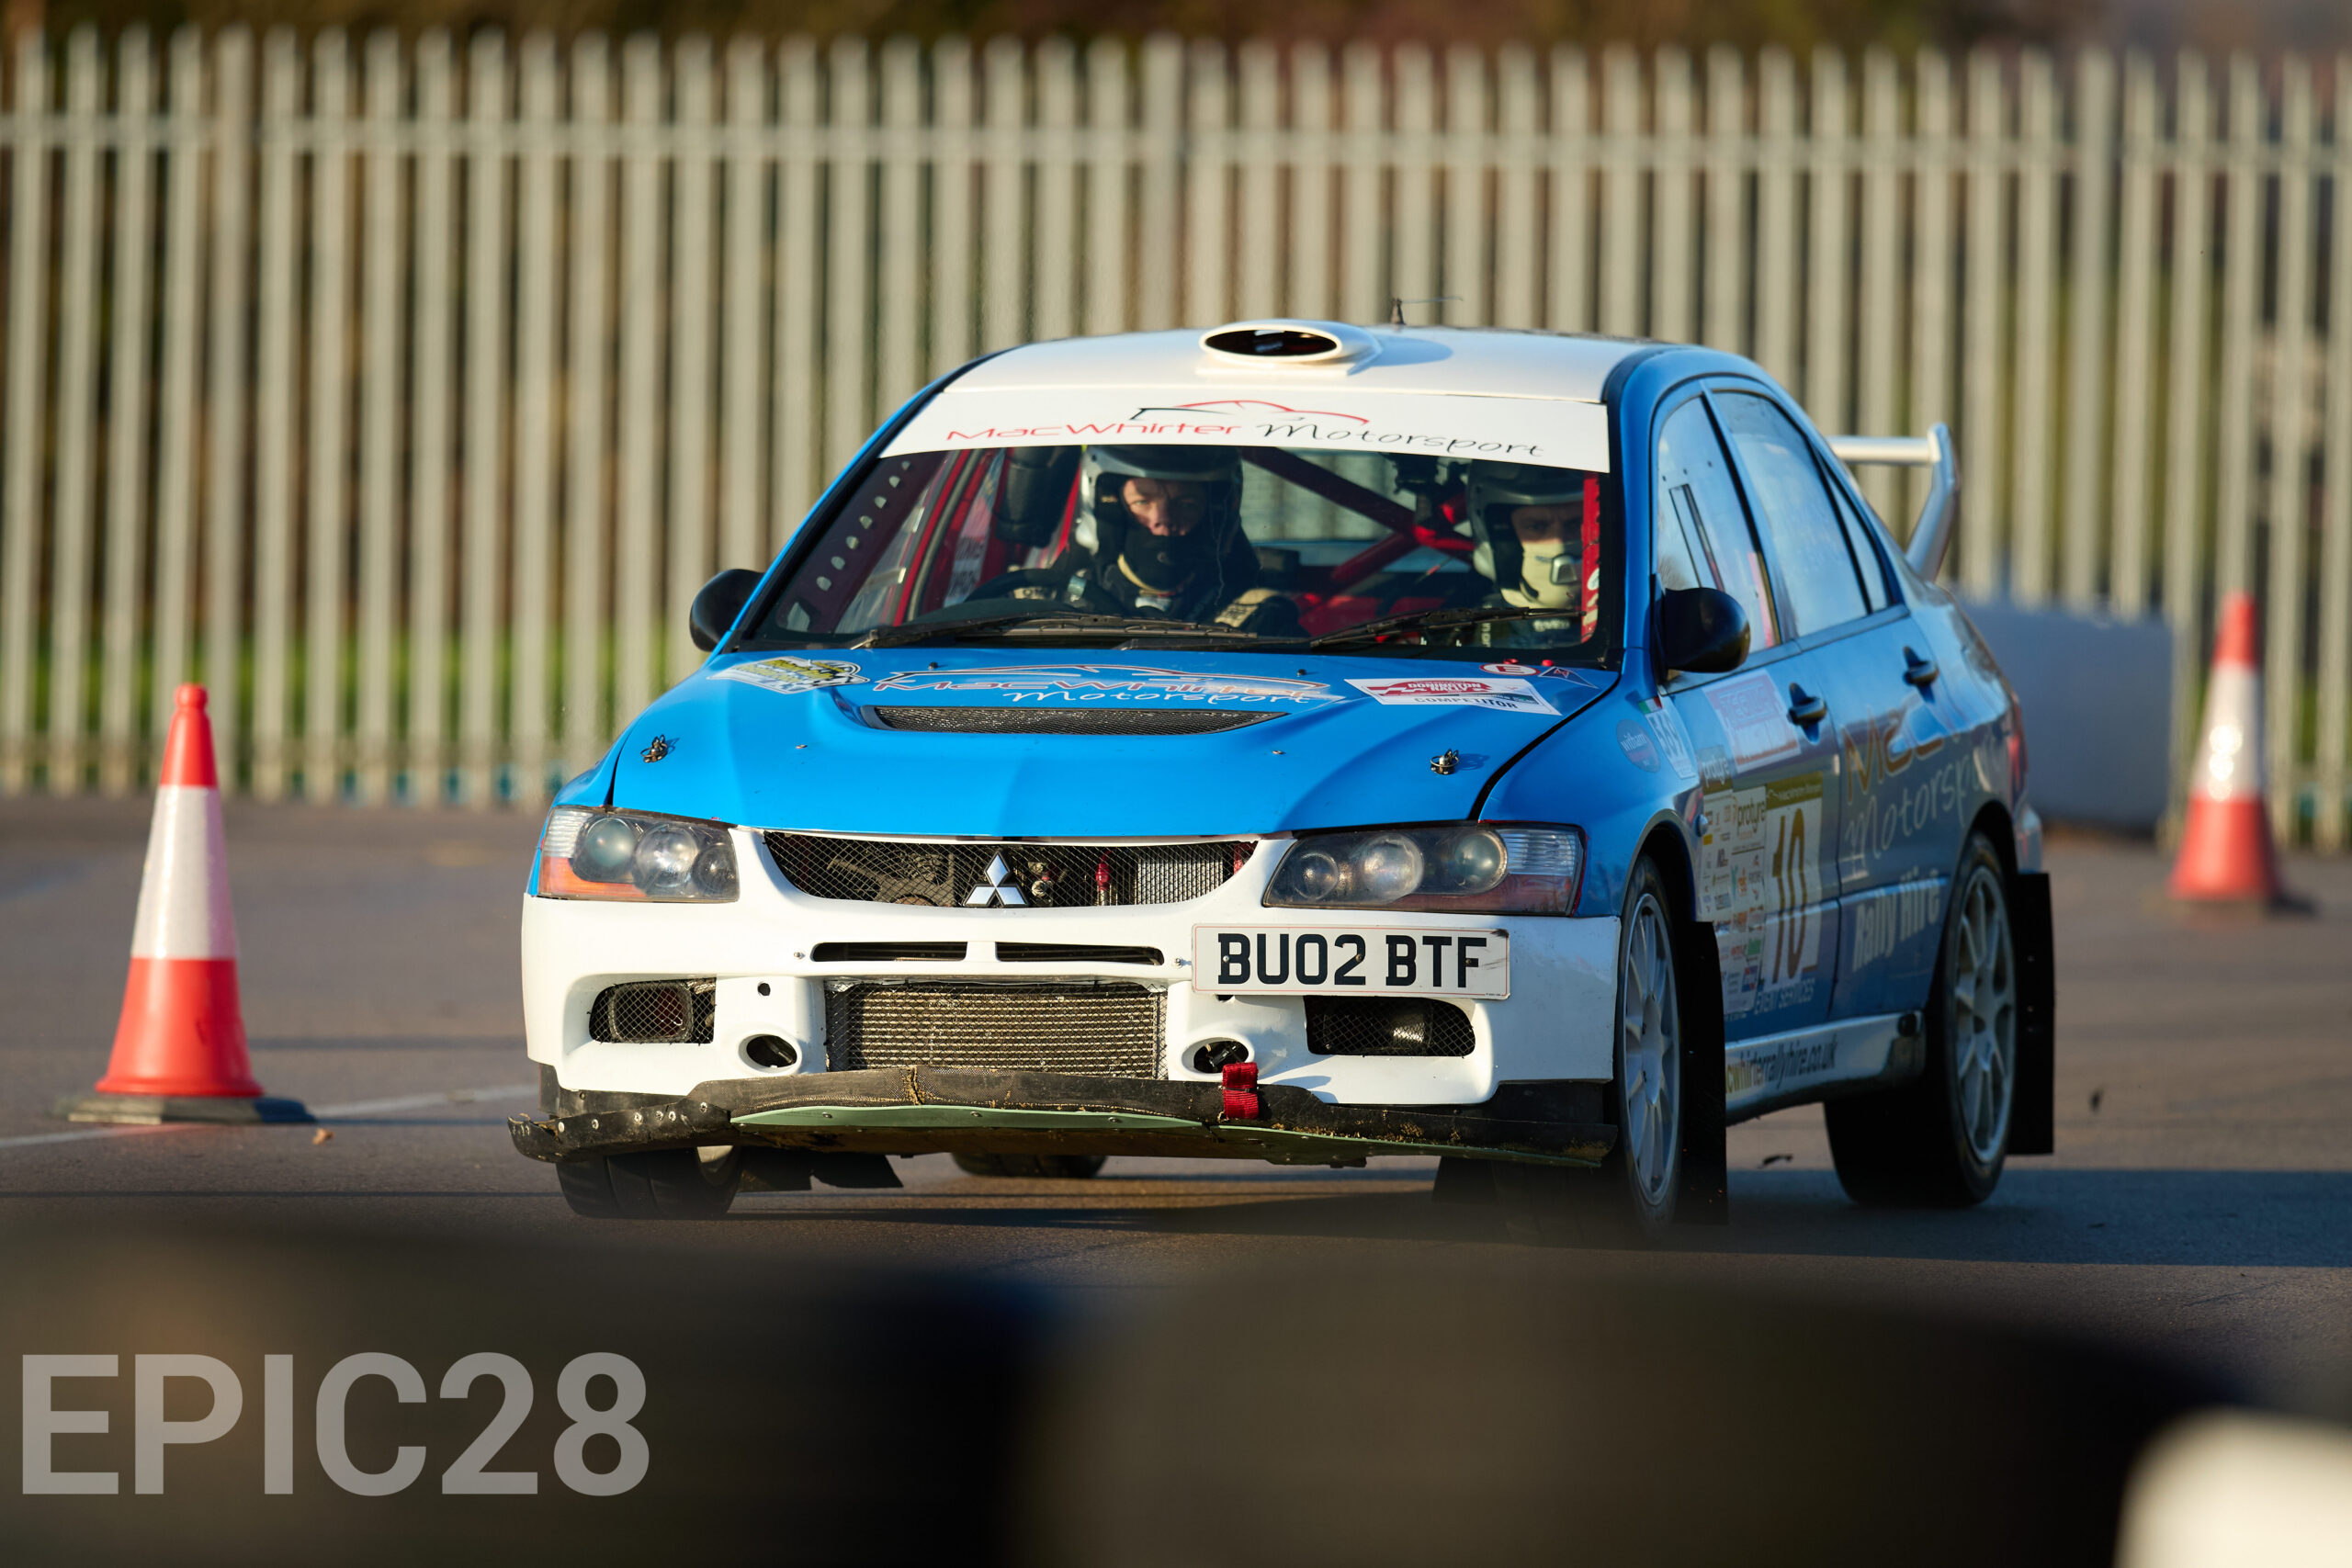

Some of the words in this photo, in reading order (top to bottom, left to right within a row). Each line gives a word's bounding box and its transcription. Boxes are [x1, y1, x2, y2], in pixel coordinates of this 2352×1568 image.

[946, 422, 1241, 442] MacWhirter
[1257, 423, 1544, 457] Motorsport
[1495, 665, 1525, 673] E
[1002, 691, 1310, 705] Motorsport
[1413, 696, 1519, 708] COMPETITOR
[1771, 807, 1808, 984] 10
[1852, 887, 1897, 972] Rally
[1899, 866, 1940, 942] Hire
[1218, 933, 1366, 986] BU02
[1385, 935, 1487, 988] BTF
[1779, 977, 1816, 1010] SERVICES
